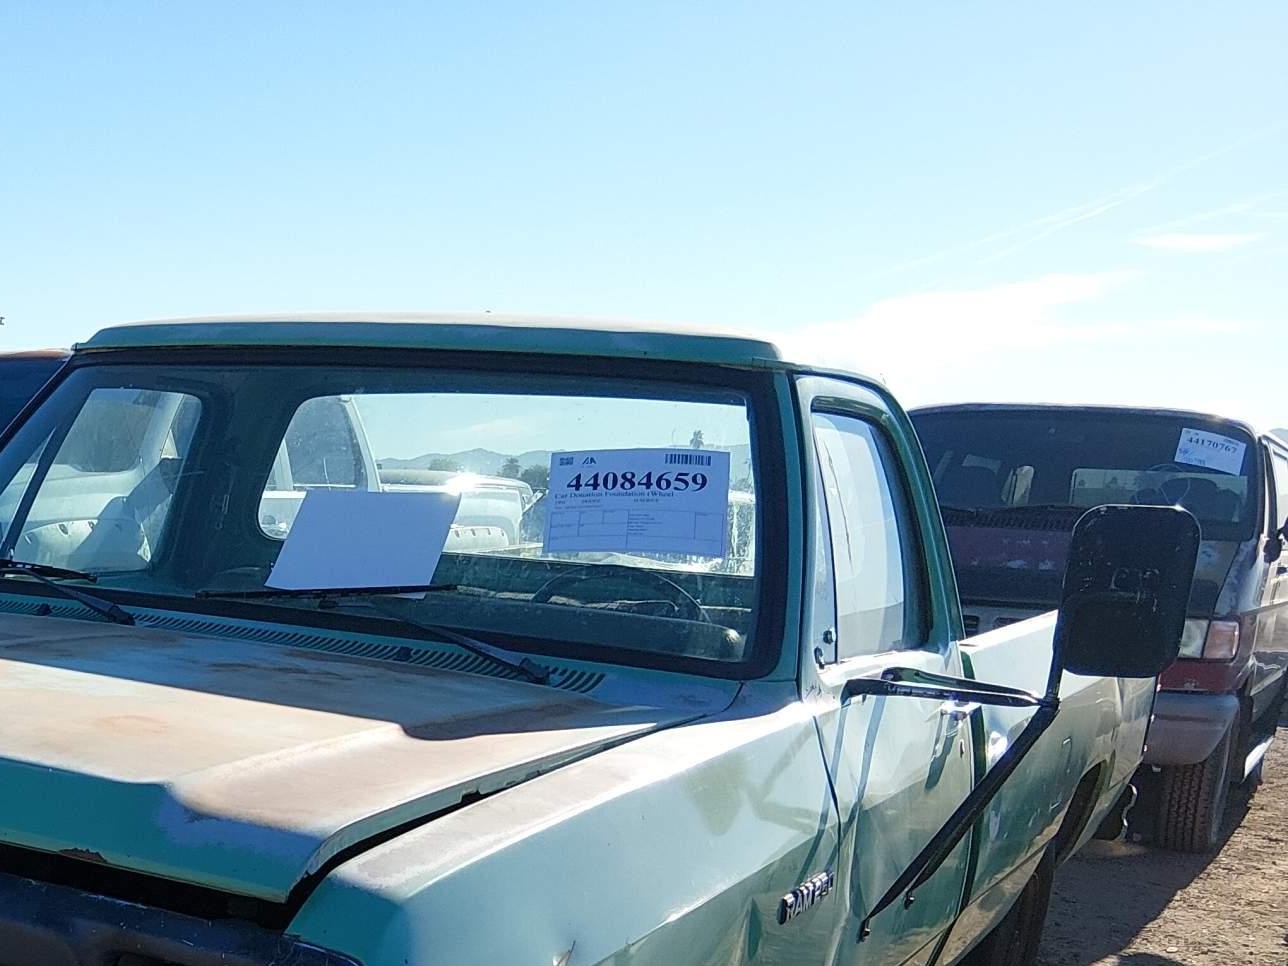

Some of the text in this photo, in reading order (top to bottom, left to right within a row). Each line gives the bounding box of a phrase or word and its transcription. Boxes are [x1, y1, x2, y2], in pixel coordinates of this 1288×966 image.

[1186, 436, 1238, 454] 44170767
[566, 471, 708, 492] 44084659
[569, 491, 603, 499] Donation
[604, 490, 646, 498] Foundation
[782, 881, 814, 921] RAM
